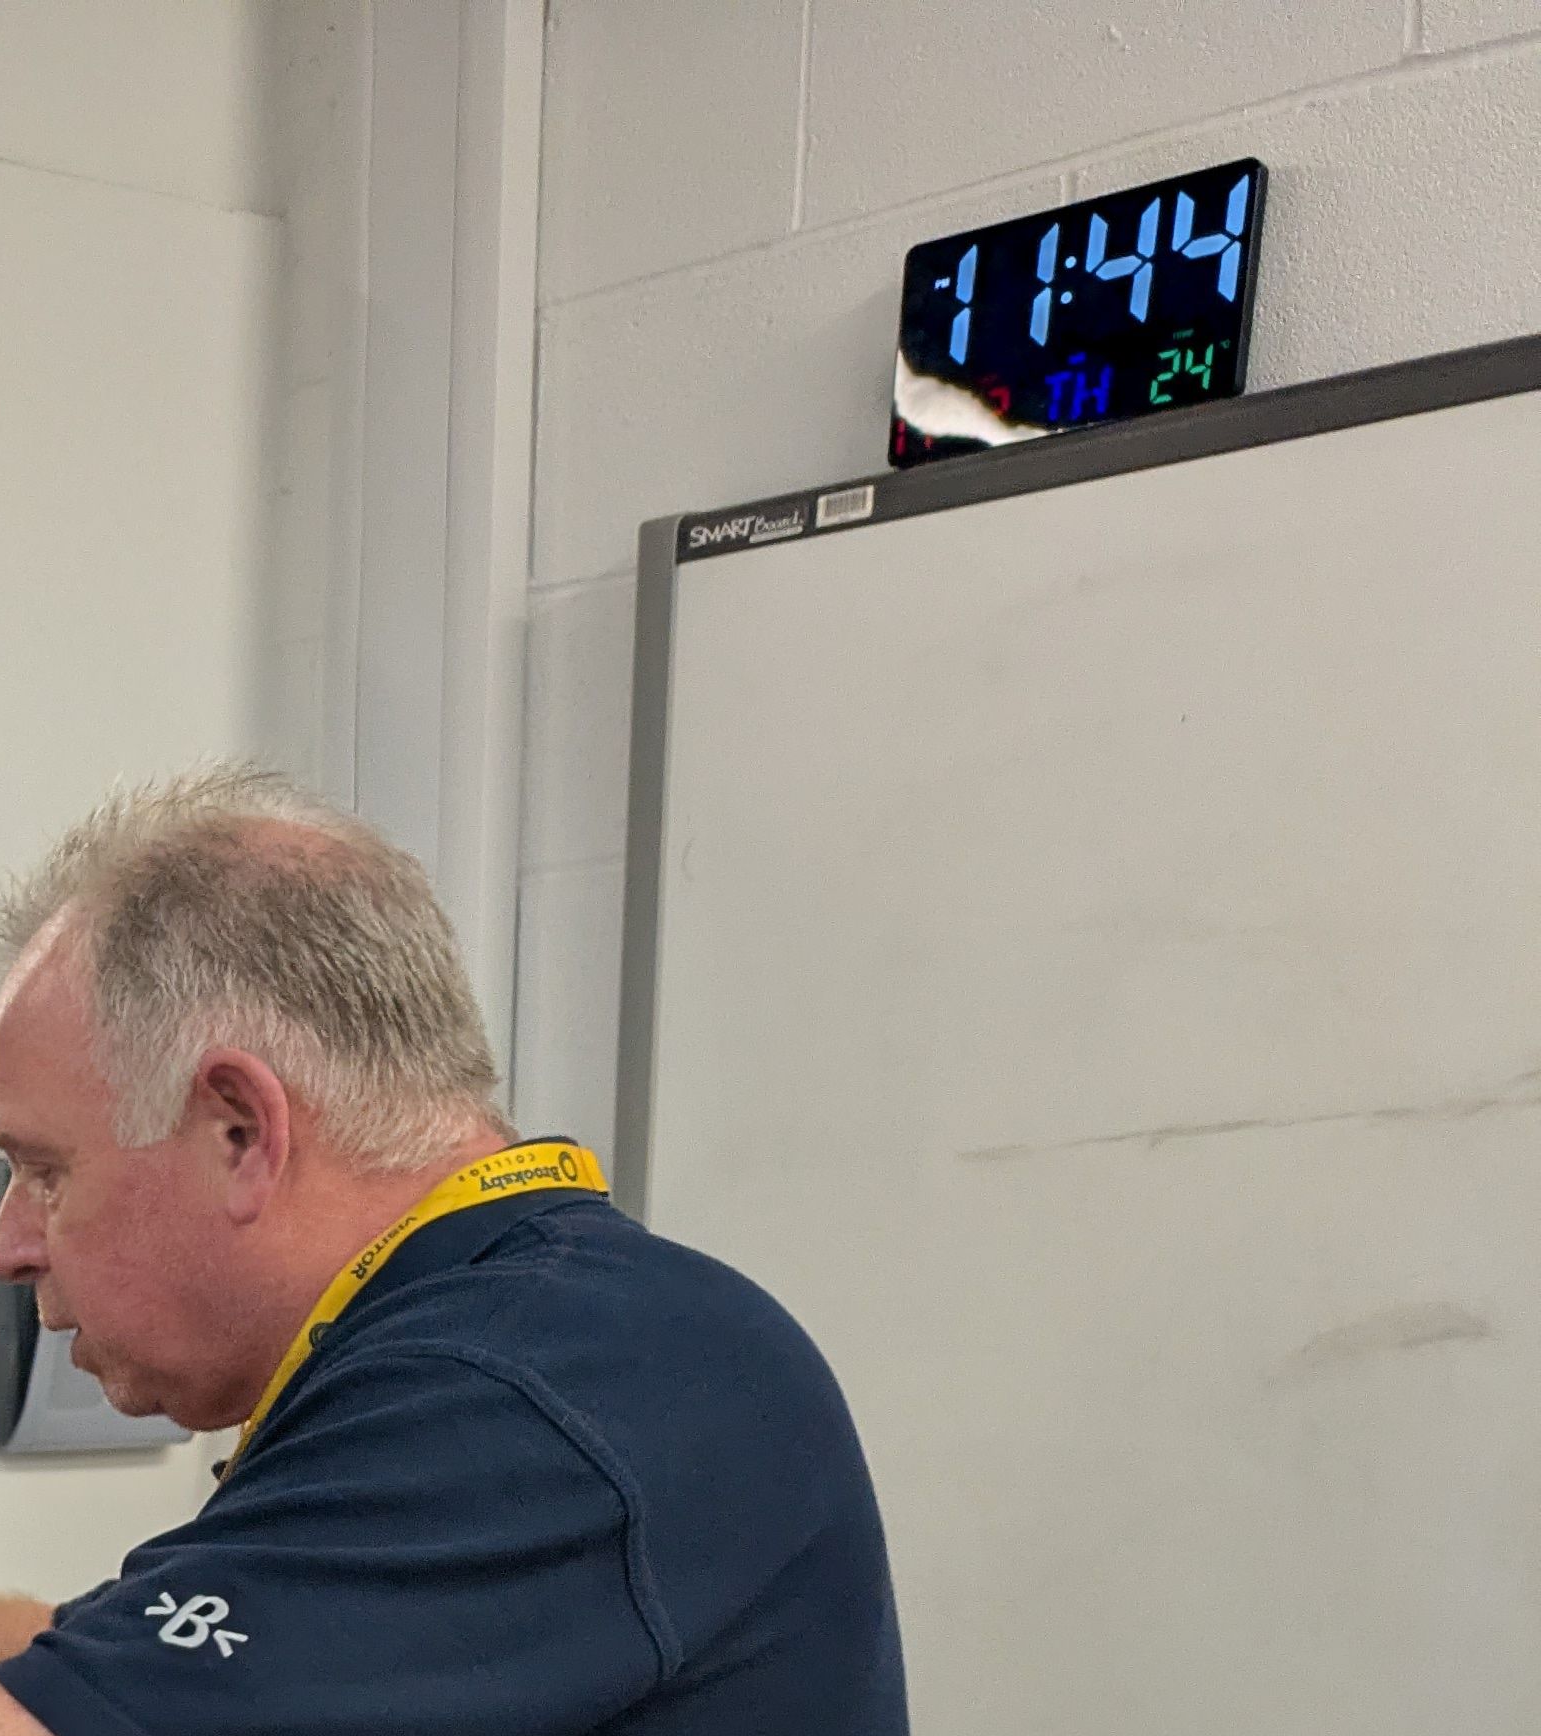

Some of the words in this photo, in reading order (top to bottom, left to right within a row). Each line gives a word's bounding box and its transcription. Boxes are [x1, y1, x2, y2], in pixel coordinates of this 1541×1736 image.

[948, 173, 1250, 366] 11:44
[1045, 363, 1114, 422] TH
[1149, 343, 1214, 406] 24
[688, 515, 755, 548] SMART
[478, 1164, 561, 1195] Brooksby
[349, 1216, 418, 1281] VISITOR
